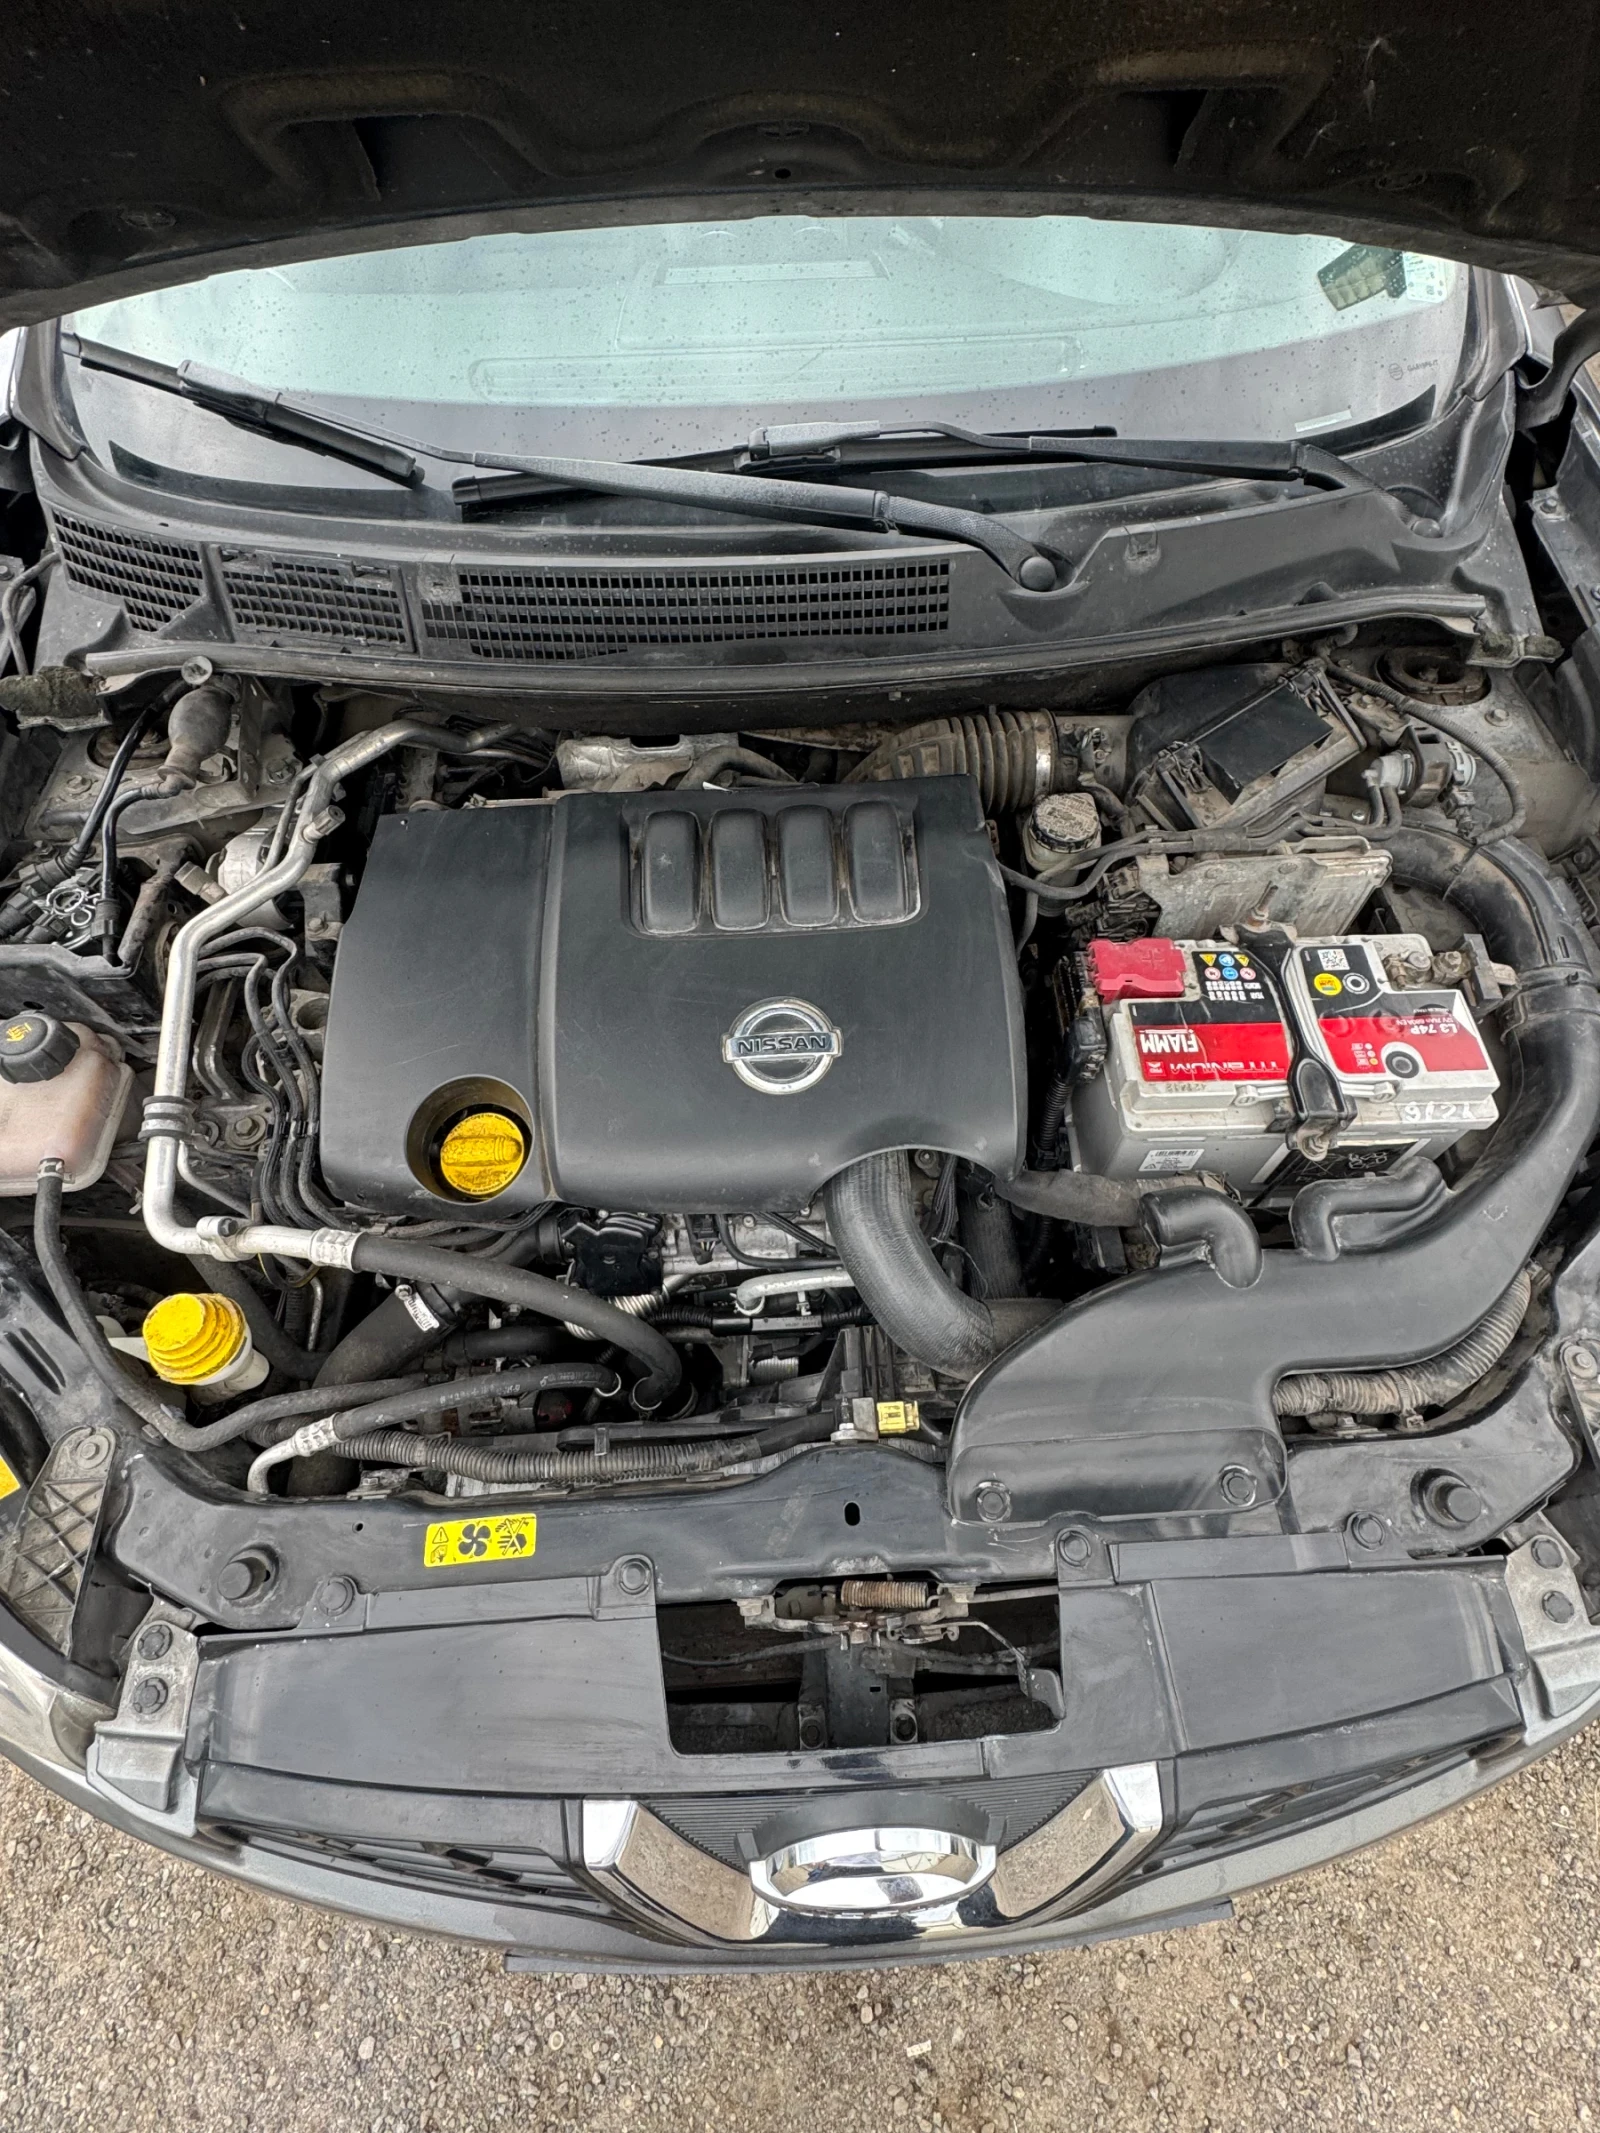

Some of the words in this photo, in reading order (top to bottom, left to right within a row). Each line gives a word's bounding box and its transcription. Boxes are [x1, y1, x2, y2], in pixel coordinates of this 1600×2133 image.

[1410, 1024, 1437, 1035] 74P
[1440, 1024, 1458, 1034] L3
[738, 1035, 827, 1054] NISSAN
[1140, 1033, 1199, 1054] FIAMM
[1170, 1061, 1285, 1075] TITANIUM
